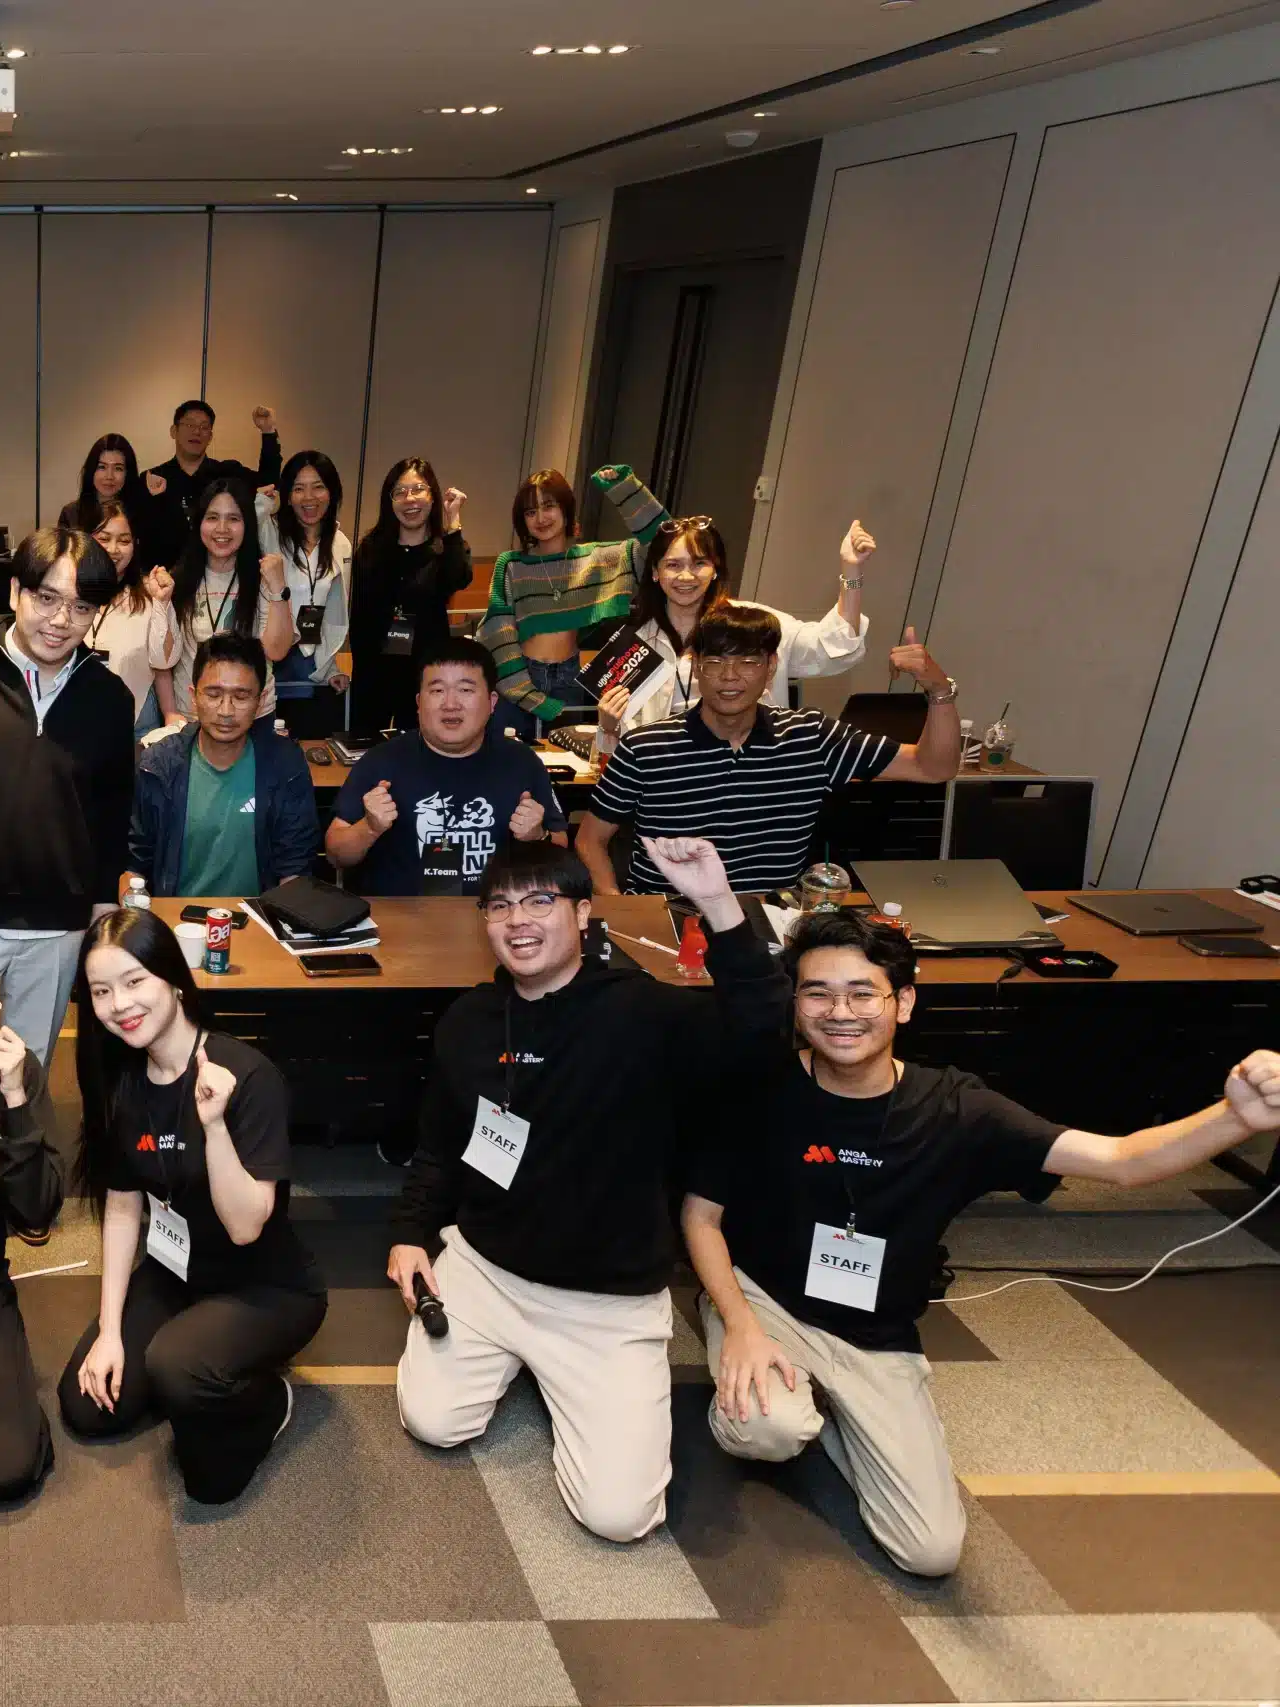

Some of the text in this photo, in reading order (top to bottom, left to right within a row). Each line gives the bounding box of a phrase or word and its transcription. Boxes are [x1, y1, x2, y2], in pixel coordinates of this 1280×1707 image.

[622, 645, 650, 674] 2025
[423, 868, 458, 876] K.Team
[158, 1134, 176, 1142] ANG
[480, 1125, 518, 1153] STAFF
[158, 1142, 186, 1150] MAERY
[838, 1149, 867, 1159] ANGA
[155, 1219, 185, 1246] STAFF
[820, 1253, 872, 1274] STAFF
